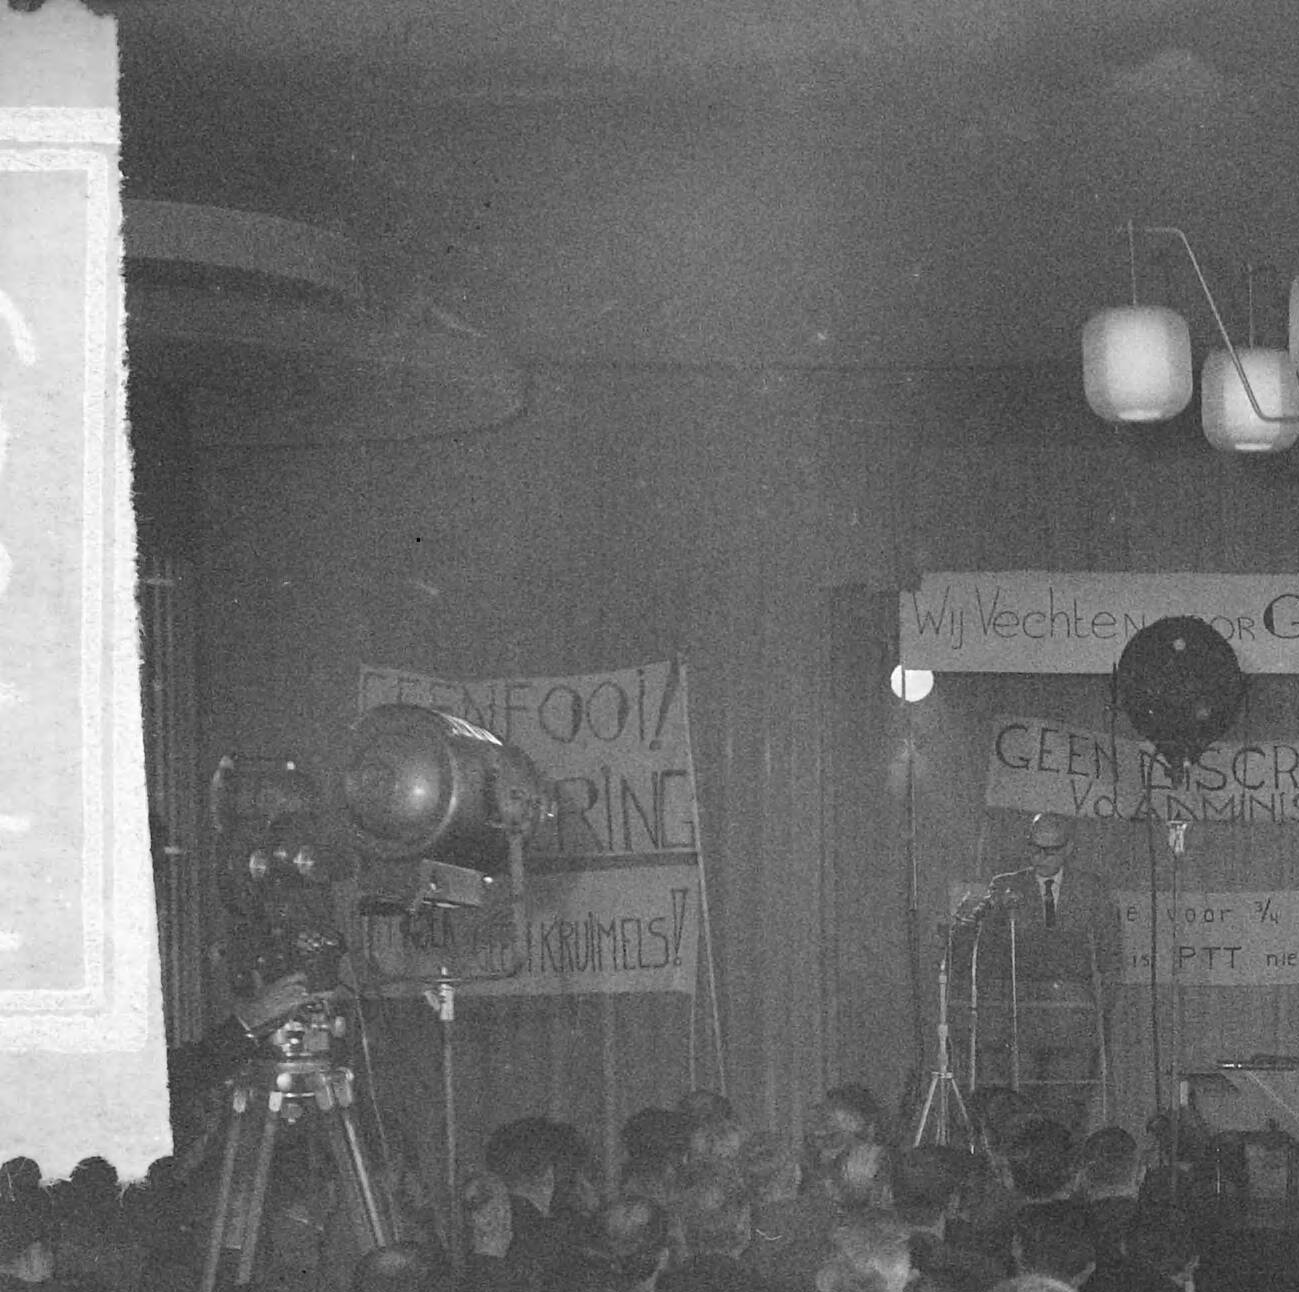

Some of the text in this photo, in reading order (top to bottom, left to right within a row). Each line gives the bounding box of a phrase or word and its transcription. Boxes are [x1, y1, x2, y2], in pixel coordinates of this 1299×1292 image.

[911, 585, 964, 650] Wij
[996, 723, 1118, 779] GEEN
[1178, 945, 1243, 970] PTT
